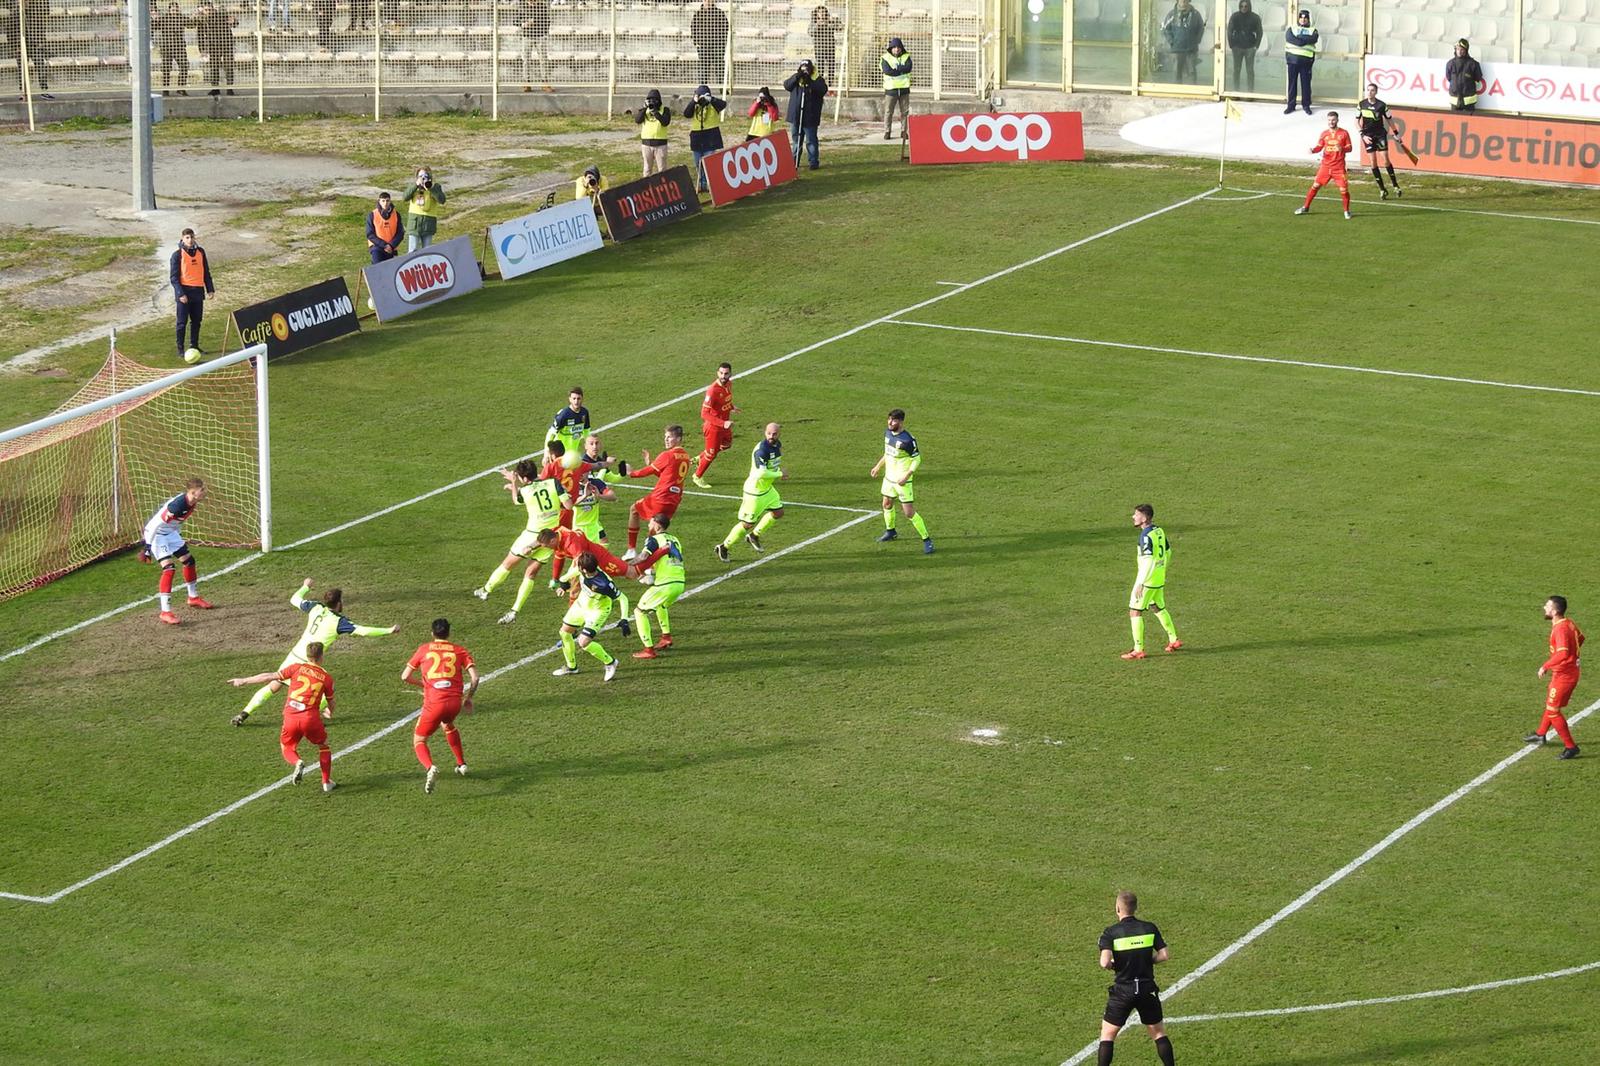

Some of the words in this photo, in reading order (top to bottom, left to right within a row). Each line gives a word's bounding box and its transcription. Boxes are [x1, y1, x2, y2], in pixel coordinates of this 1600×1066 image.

[941, 113, 1052, 160] coop
[722, 138, 778, 189] coop
[617, 176, 683, 220] mastria
[644, 201, 687, 223] VENDING
[398, 261, 449, 295] Wüber
[242, 321, 272, 344] Caffè
[288, 295, 353, 332] GUGLIELMO
[678, 461, 688, 484] 9
[533, 488, 553, 512] 13
[310, 614, 323, 635] 6
[426, 651, 457, 679] 23
[290, 675, 324, 705] 21
